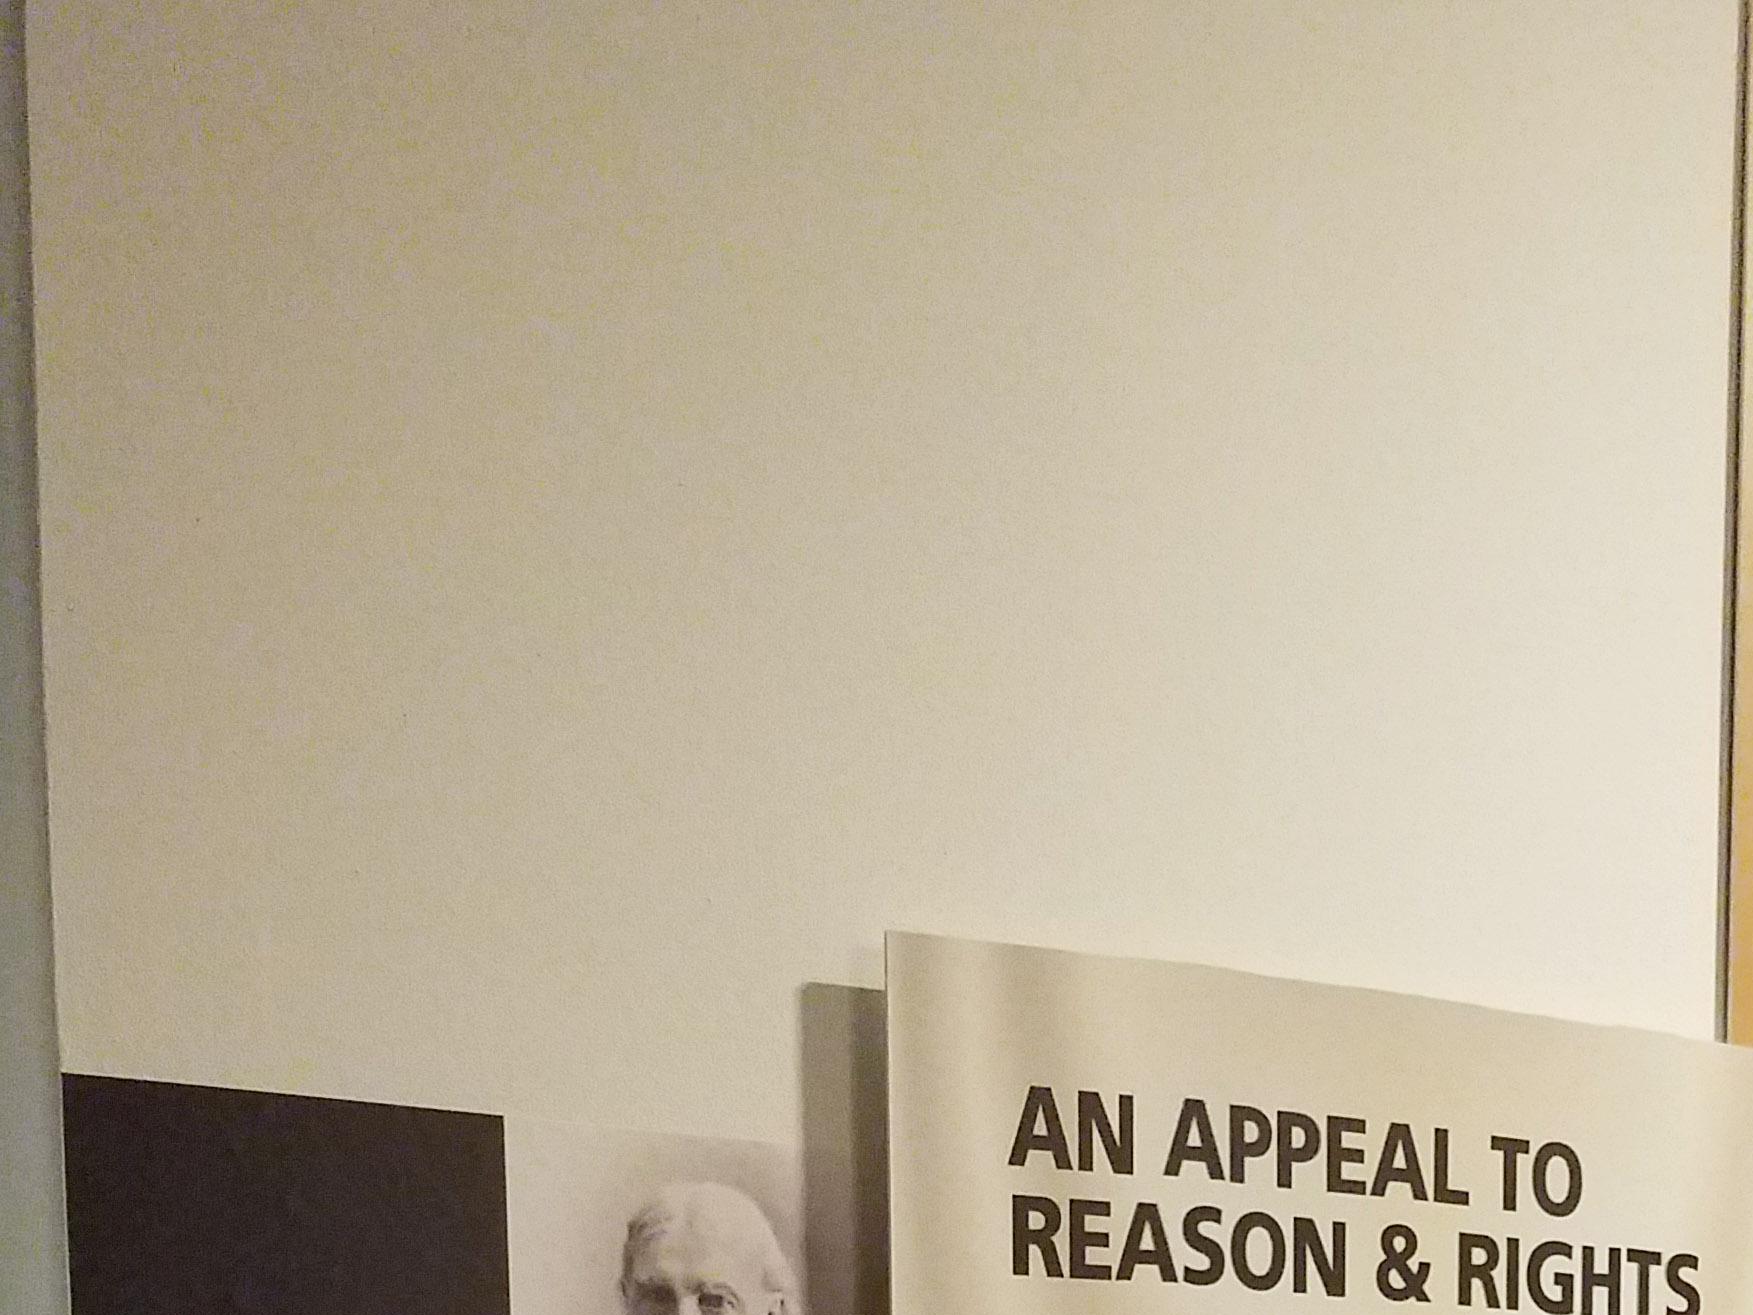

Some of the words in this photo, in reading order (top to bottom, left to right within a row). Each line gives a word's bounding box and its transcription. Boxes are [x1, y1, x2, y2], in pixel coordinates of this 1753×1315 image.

[1006, 1084, 1134, 1176] AN
[1162, 1096, 1470, 1206] APPEAL
[1489, 1133, 1583, 1218] TO
[1010, 1193, 1347, 1298] REASON
[1374, 1222, 1432, 1303] &
